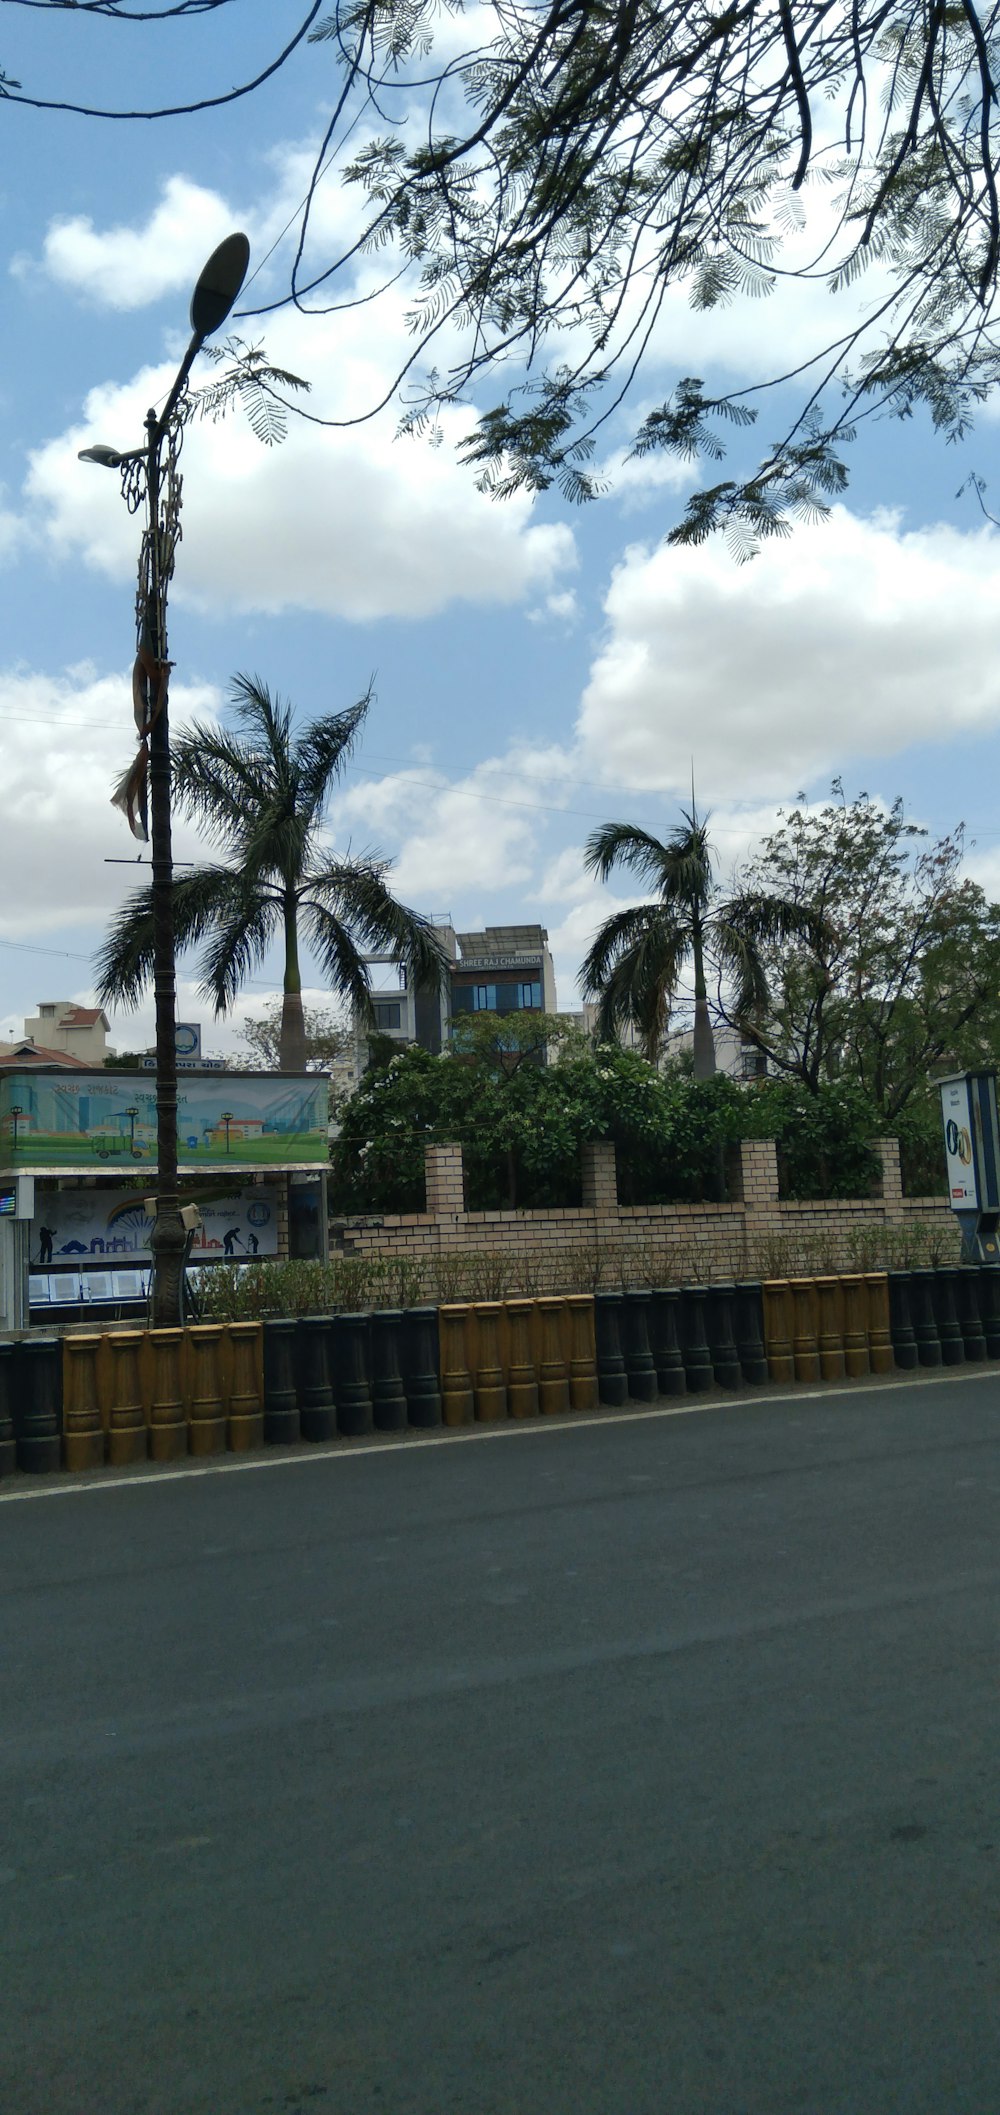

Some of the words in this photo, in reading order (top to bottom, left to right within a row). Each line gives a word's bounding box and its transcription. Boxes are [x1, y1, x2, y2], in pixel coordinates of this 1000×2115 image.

[459, 959, 483, 968] SHREE
[484, 958, 499, 966] RAJ
[500, 956, 541, 965] CHAMUNDA
